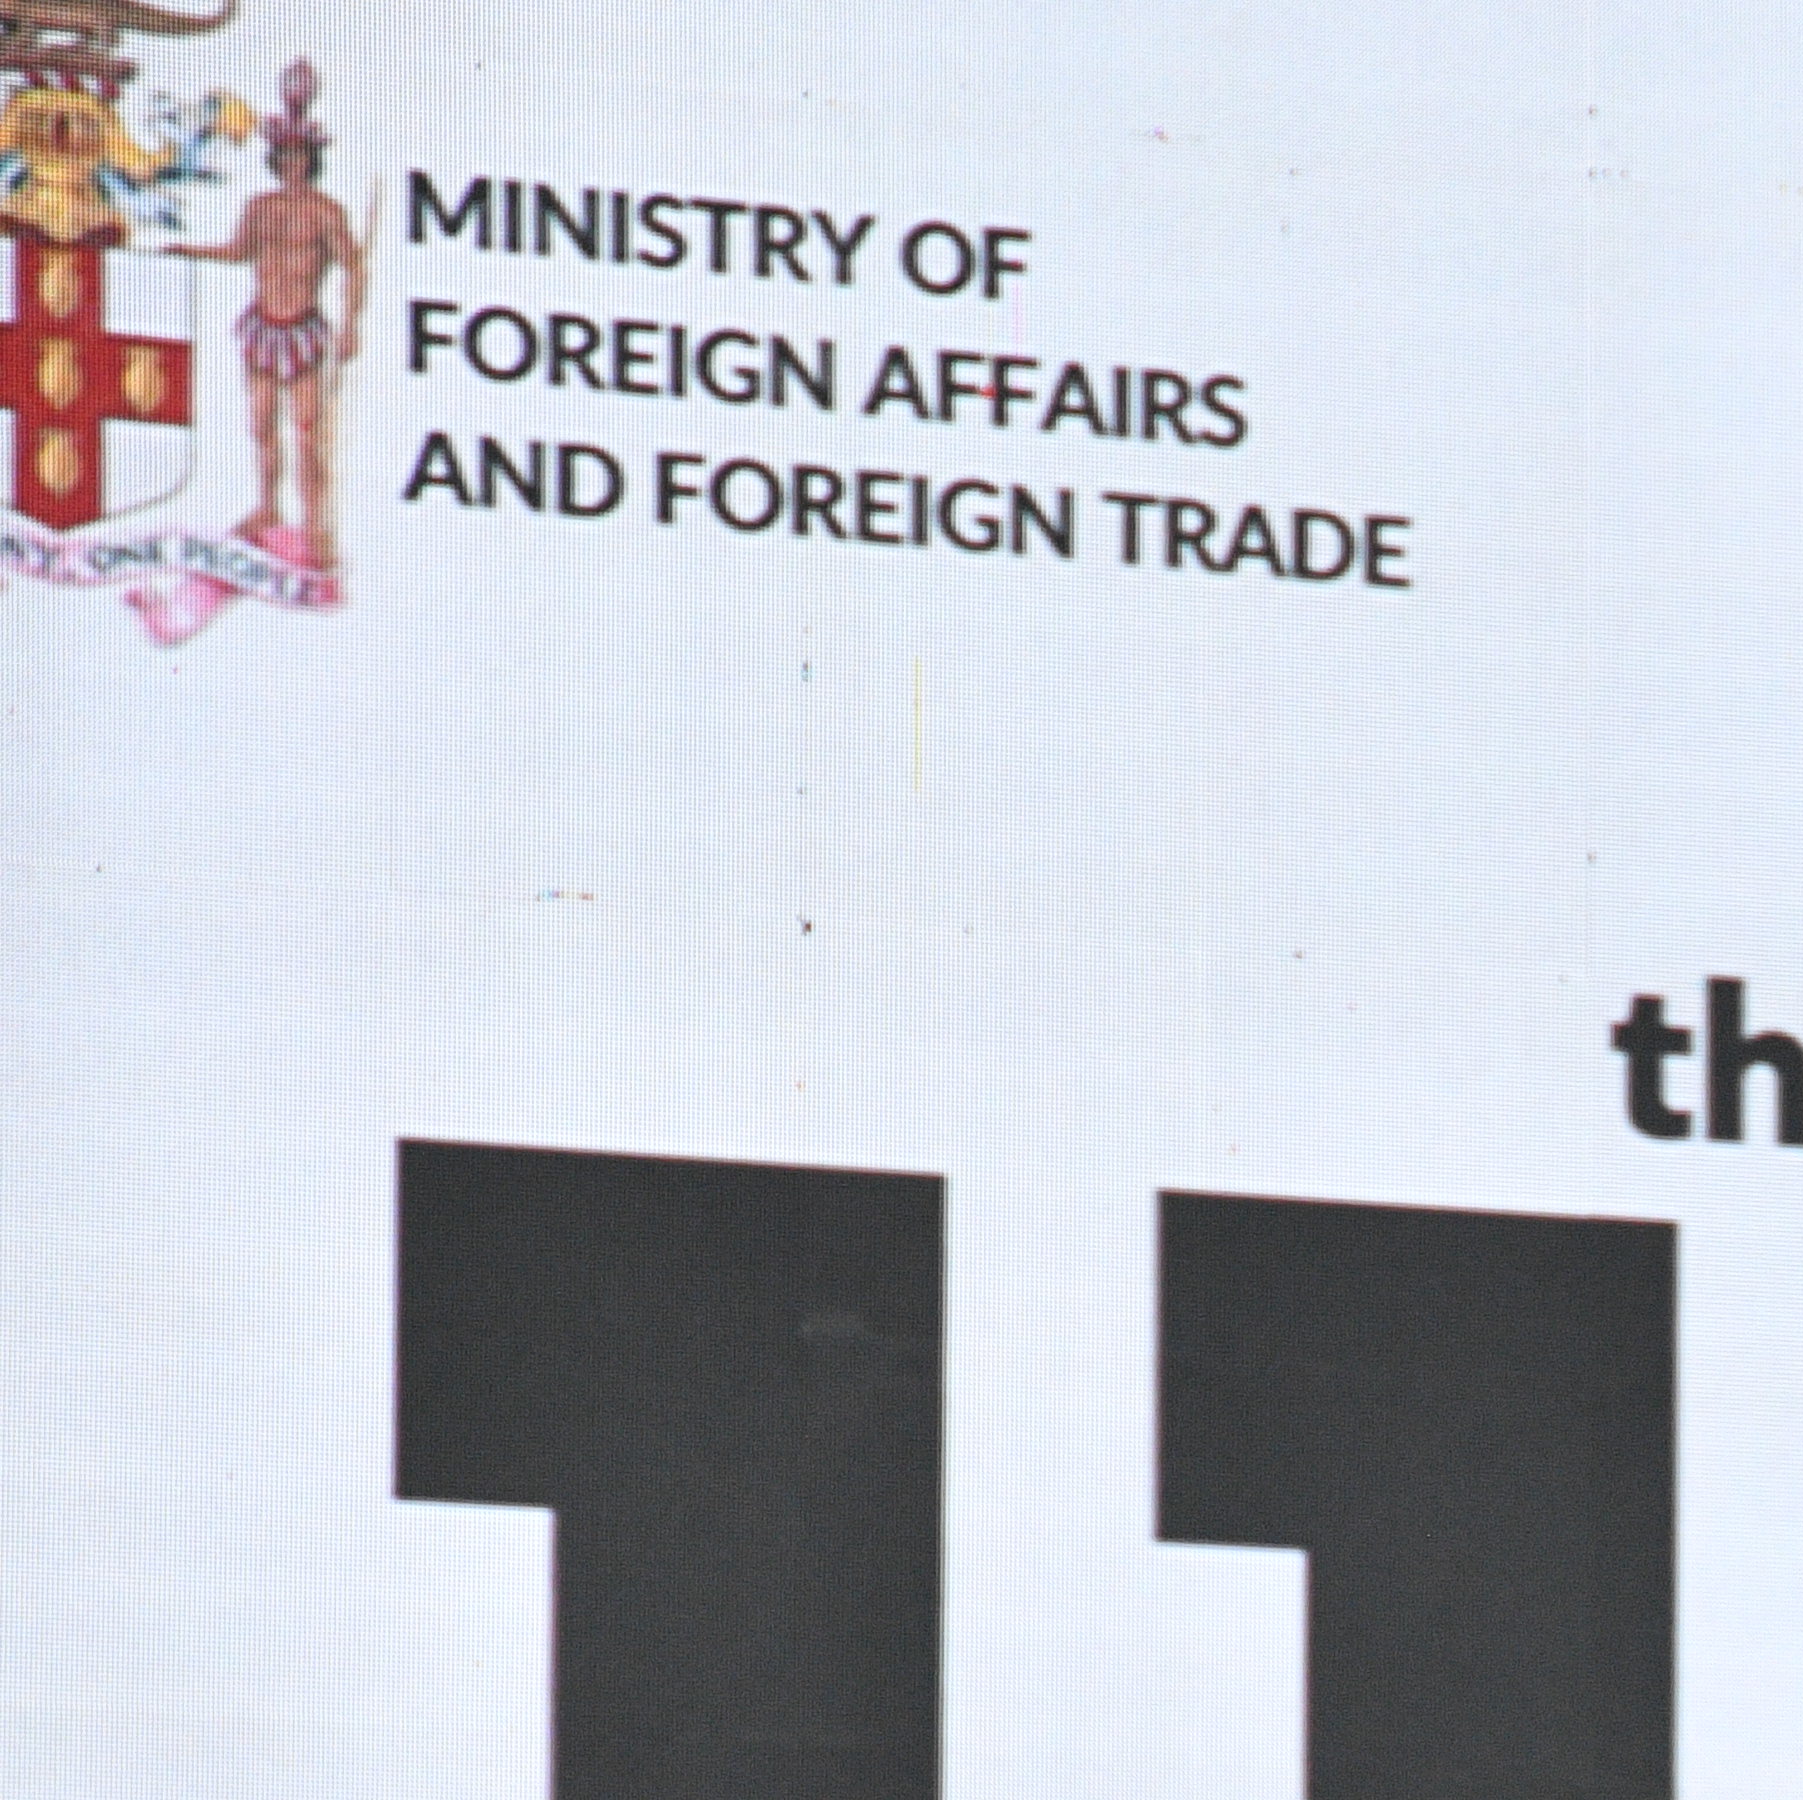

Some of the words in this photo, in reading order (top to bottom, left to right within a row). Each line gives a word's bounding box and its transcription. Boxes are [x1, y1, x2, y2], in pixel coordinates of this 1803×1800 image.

[408, 169, 875, 286] MINISTRY
[900, 221, 1031, 300] OF
[408, 299, 835, 411] FOREIGN
[862, 346, 1248, 449] AFFAIRS
[403, 431, 625, 518] AND
[656, 451, 1074, 559] FOREIGN
[1102, 491, 1411, 589] TRADE
